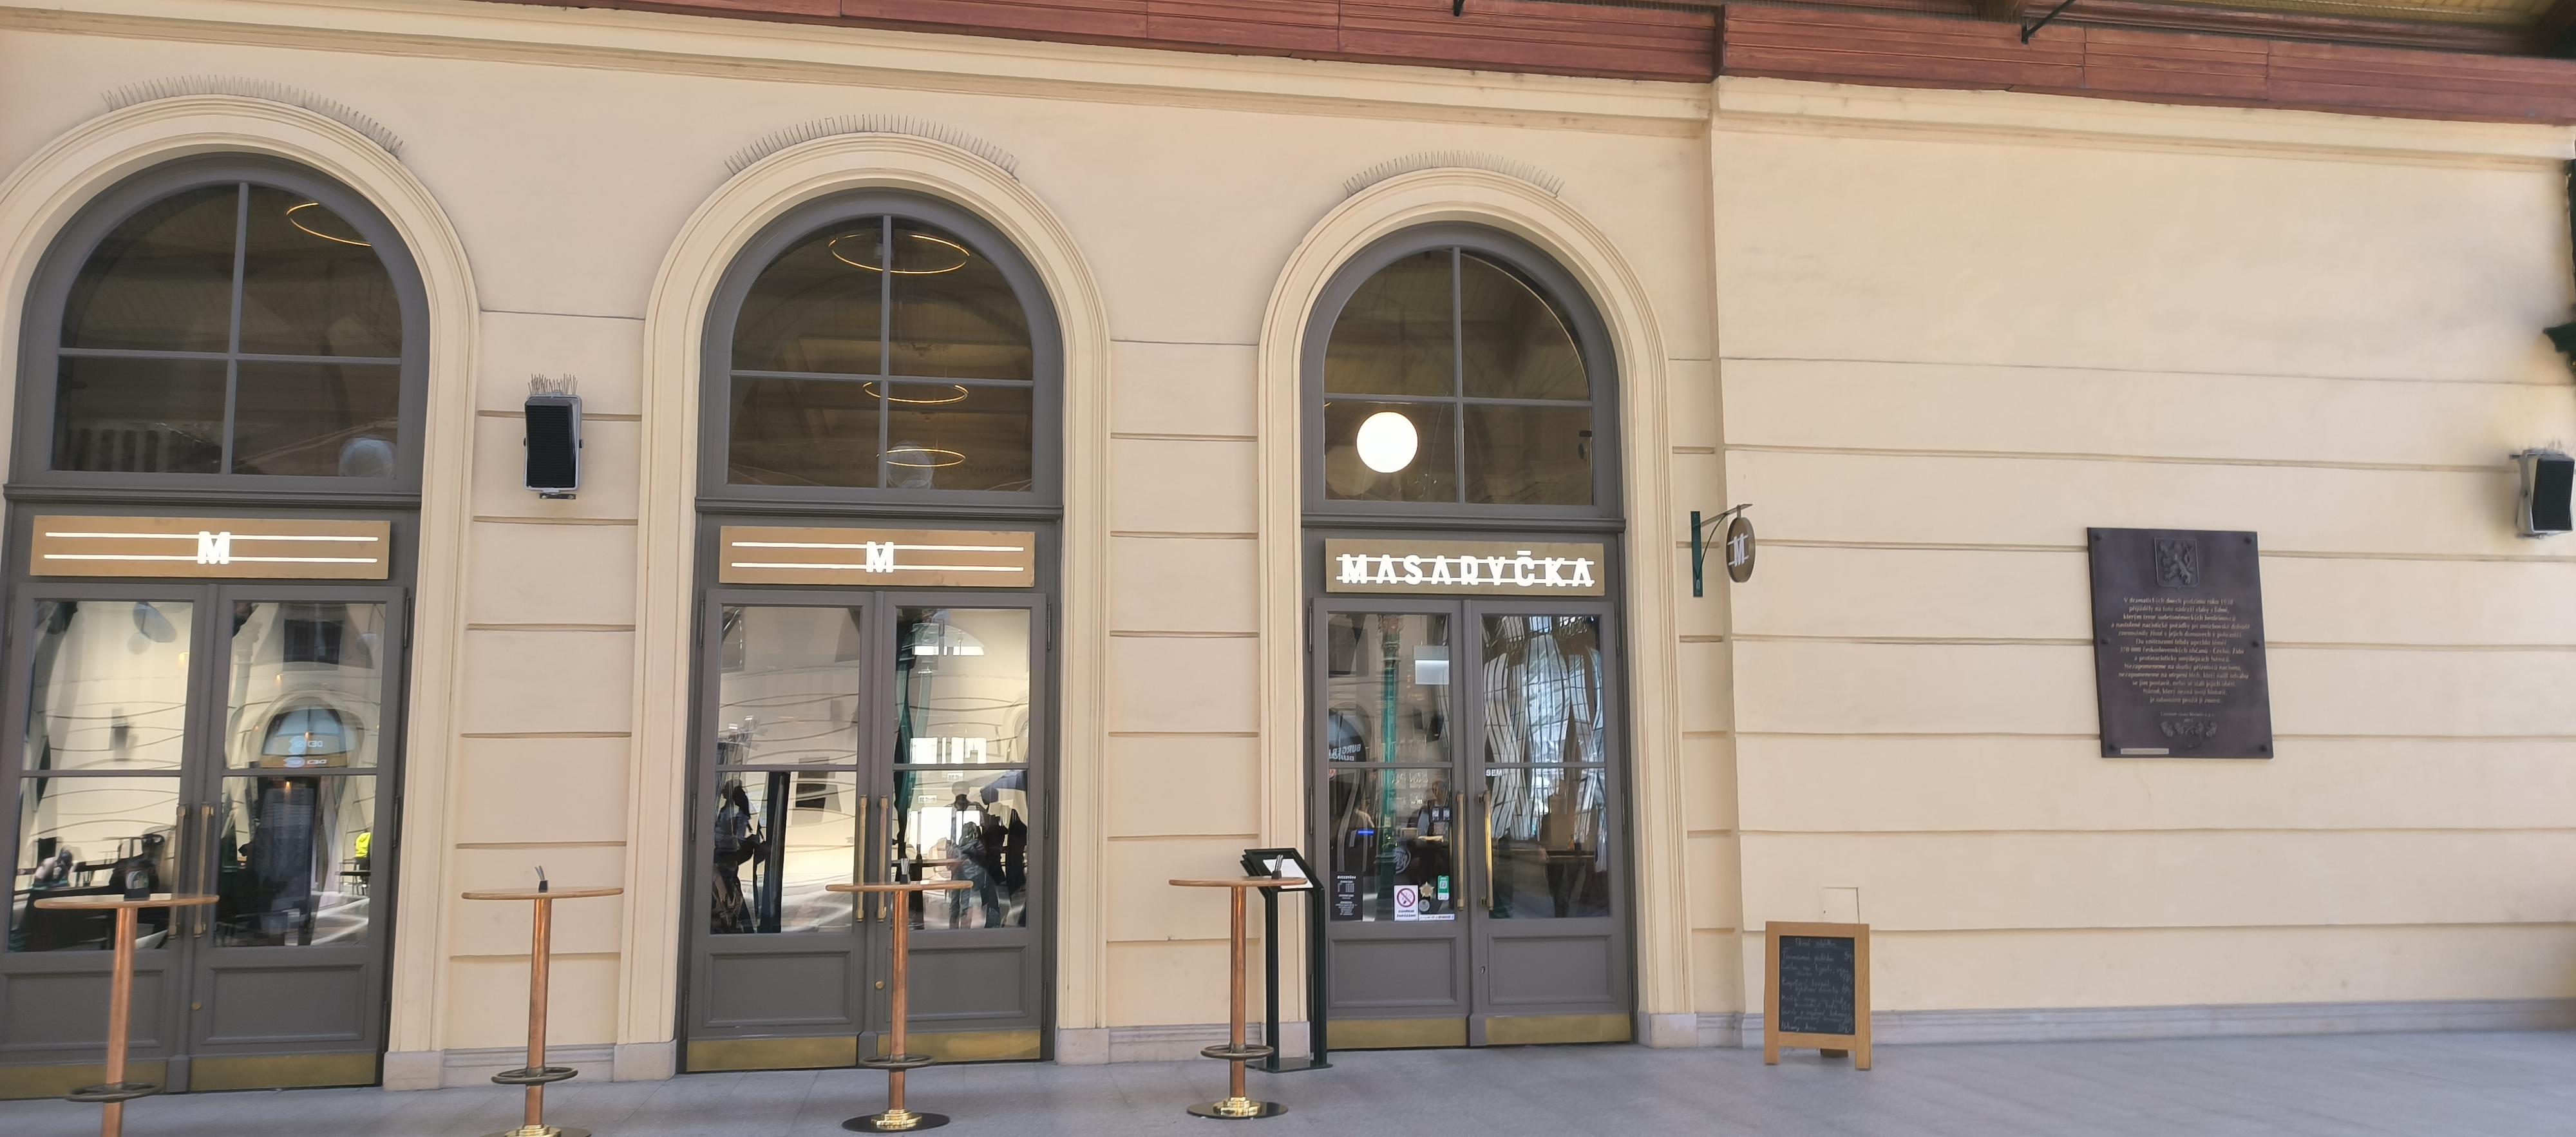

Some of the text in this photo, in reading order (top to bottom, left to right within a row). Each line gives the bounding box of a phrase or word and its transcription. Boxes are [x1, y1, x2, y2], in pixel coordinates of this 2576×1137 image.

[197, 531, 231, 565] M
[866, 541, 894, 573] M
[1341, 550, 1594, 587] MASARYČKA
[1485, 768, 1502, 777] SEM
